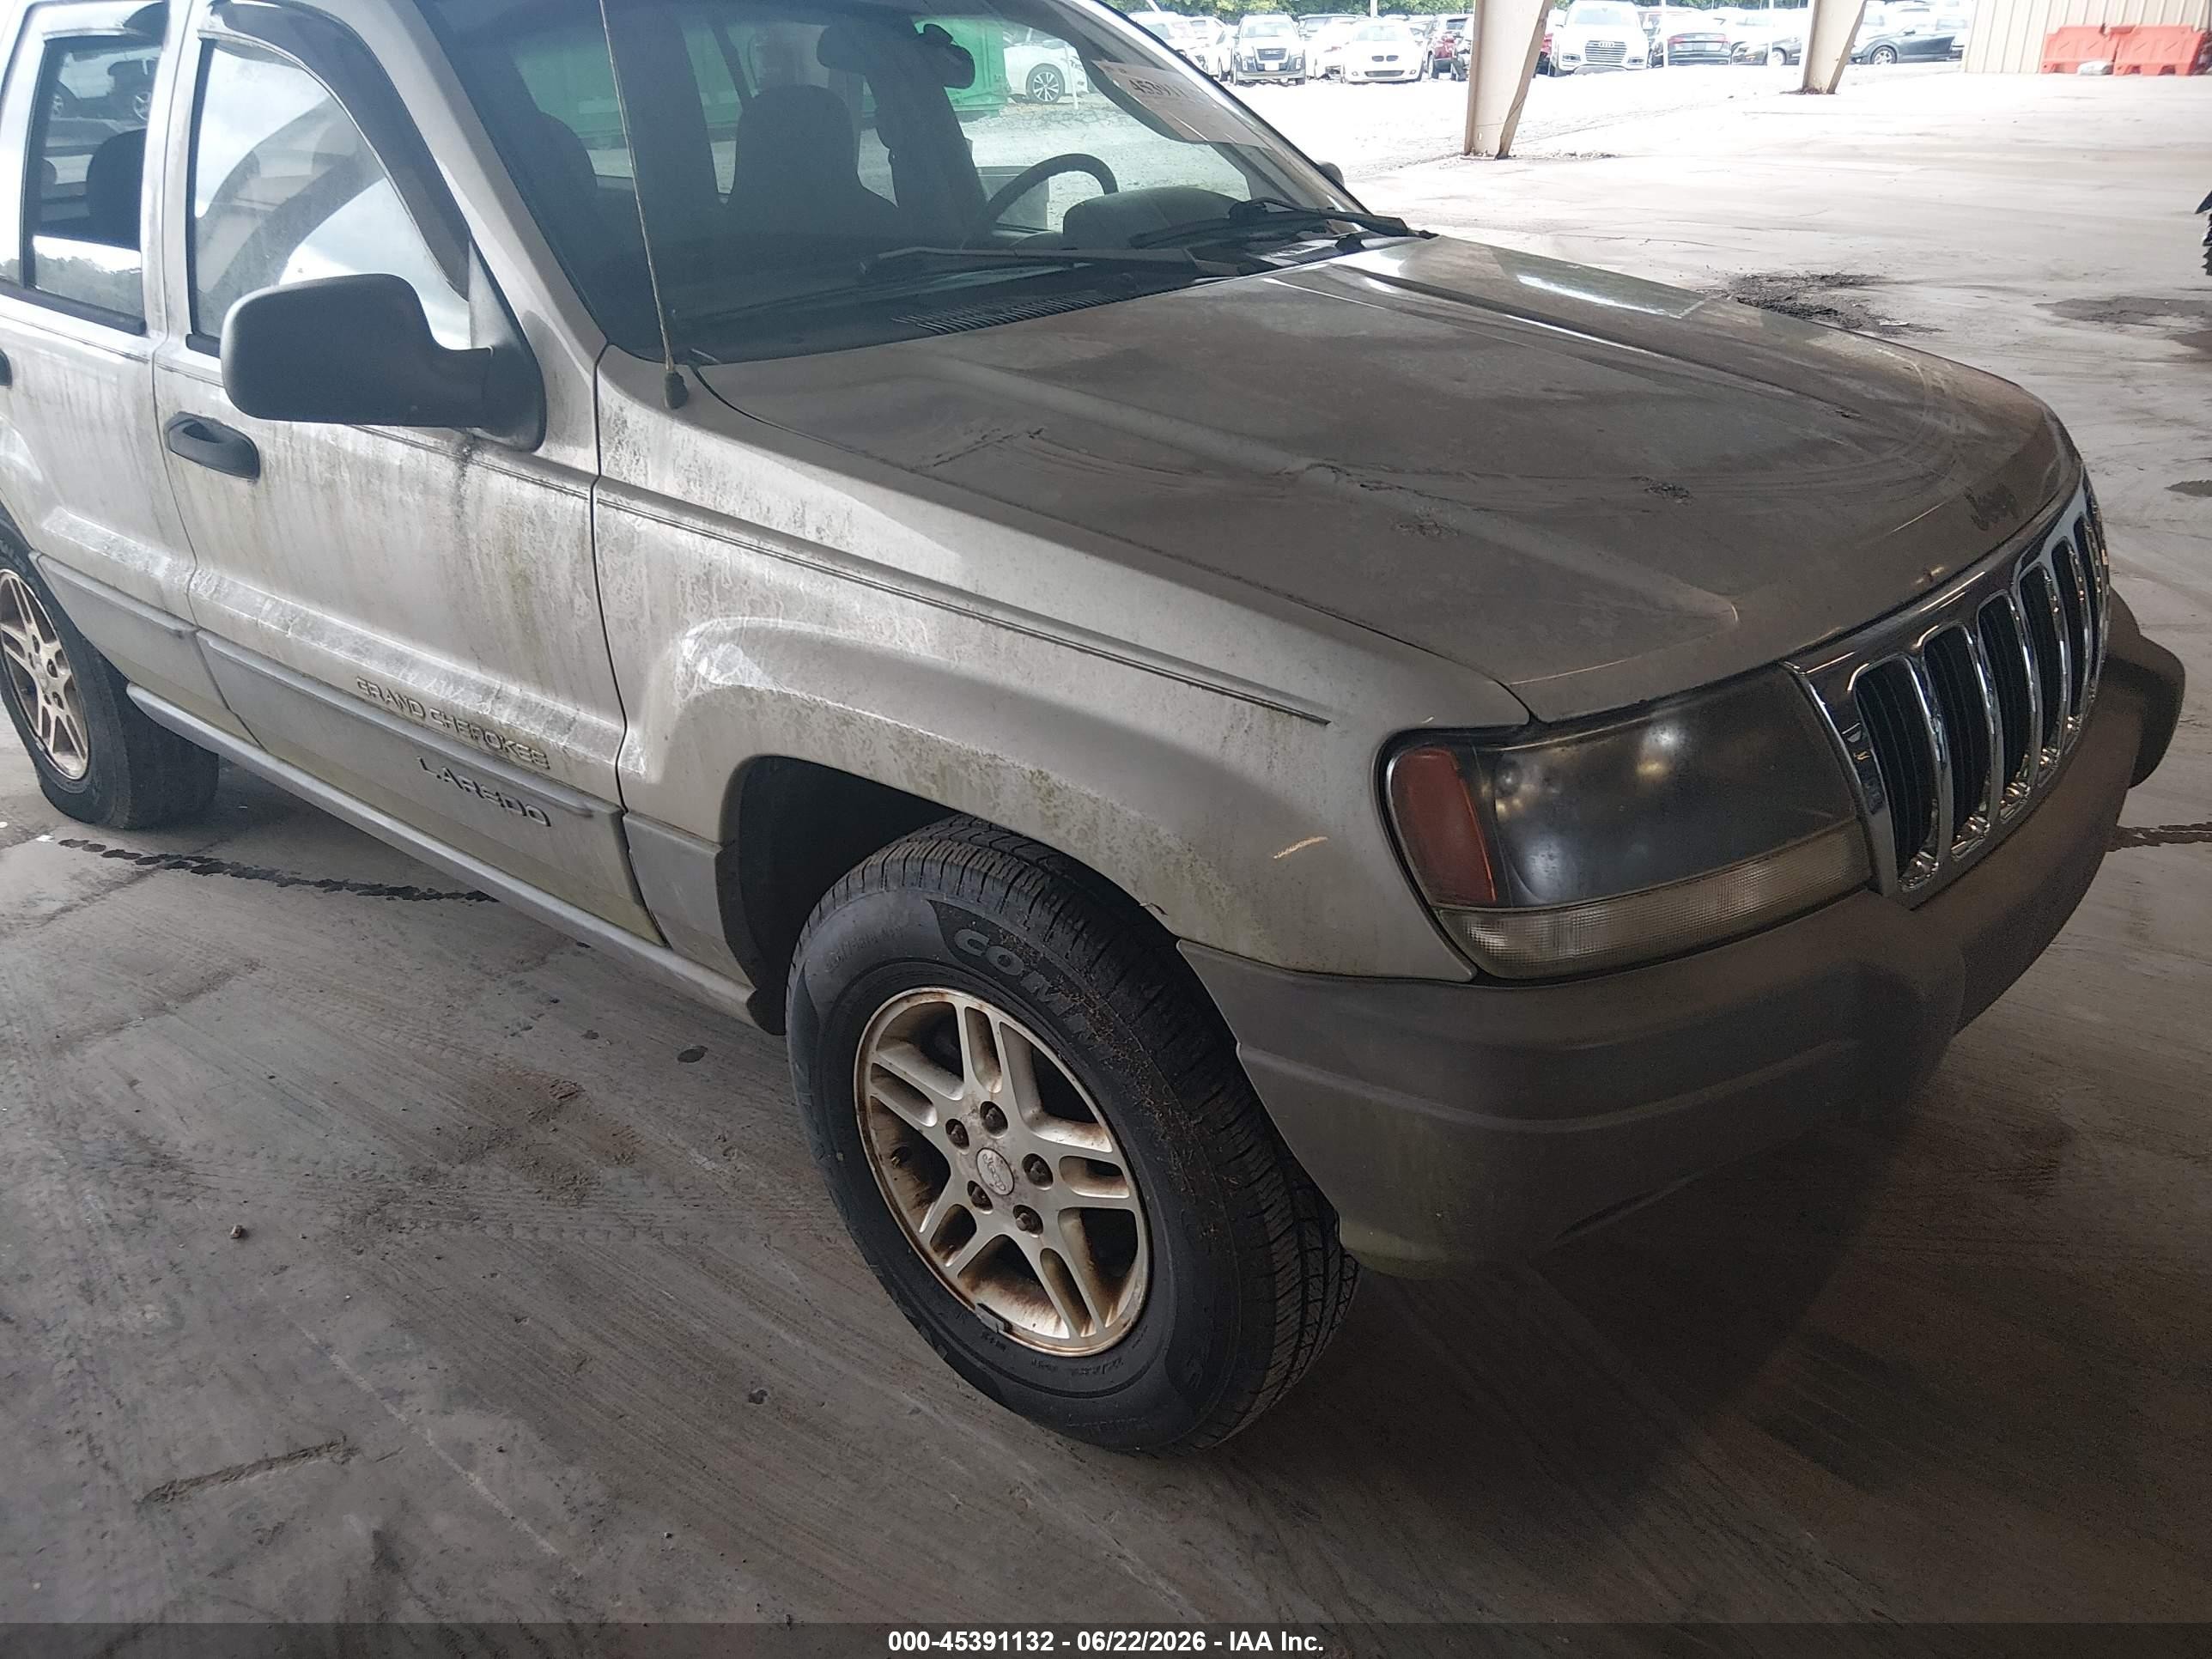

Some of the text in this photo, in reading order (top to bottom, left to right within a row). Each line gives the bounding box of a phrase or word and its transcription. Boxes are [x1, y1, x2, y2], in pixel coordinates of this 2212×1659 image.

[356, 677, 551, 769] GRAND CHEROKEE
[416, 756, 552, 827] LAREDO
